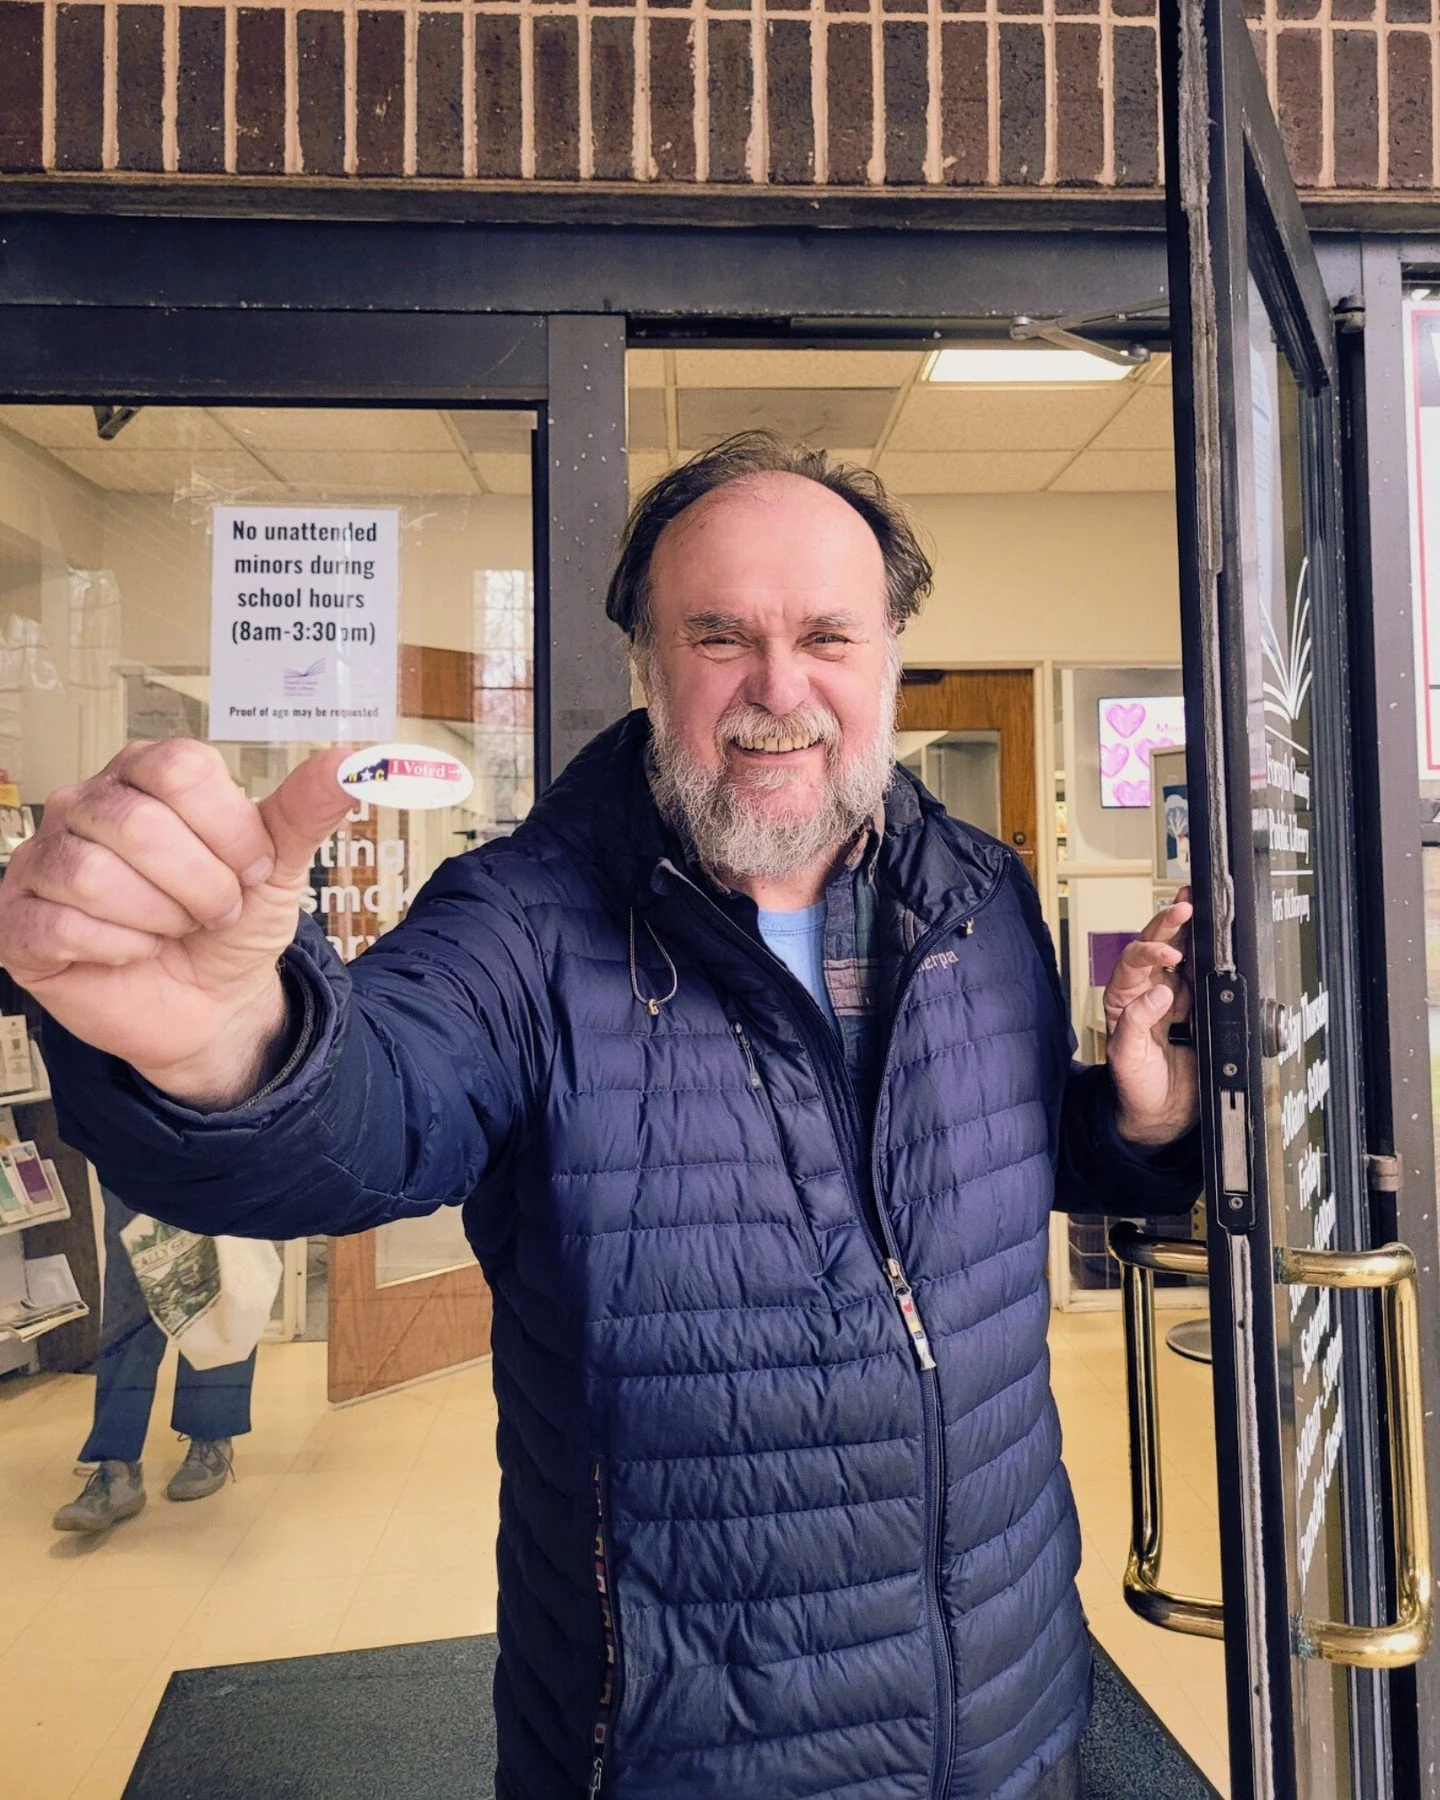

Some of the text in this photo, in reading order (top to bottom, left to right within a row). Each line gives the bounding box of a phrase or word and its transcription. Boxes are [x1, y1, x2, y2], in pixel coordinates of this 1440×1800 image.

[233, 520, 377, 541] No unattended
[235, 554, 375, 579] minors during
[238, 588, 365, 608] school hours
[229, 706, 379, 719] Proof of age may be requested
[403, 761, 446, 778] Voted
[918, 950, 959, 972] erpa
